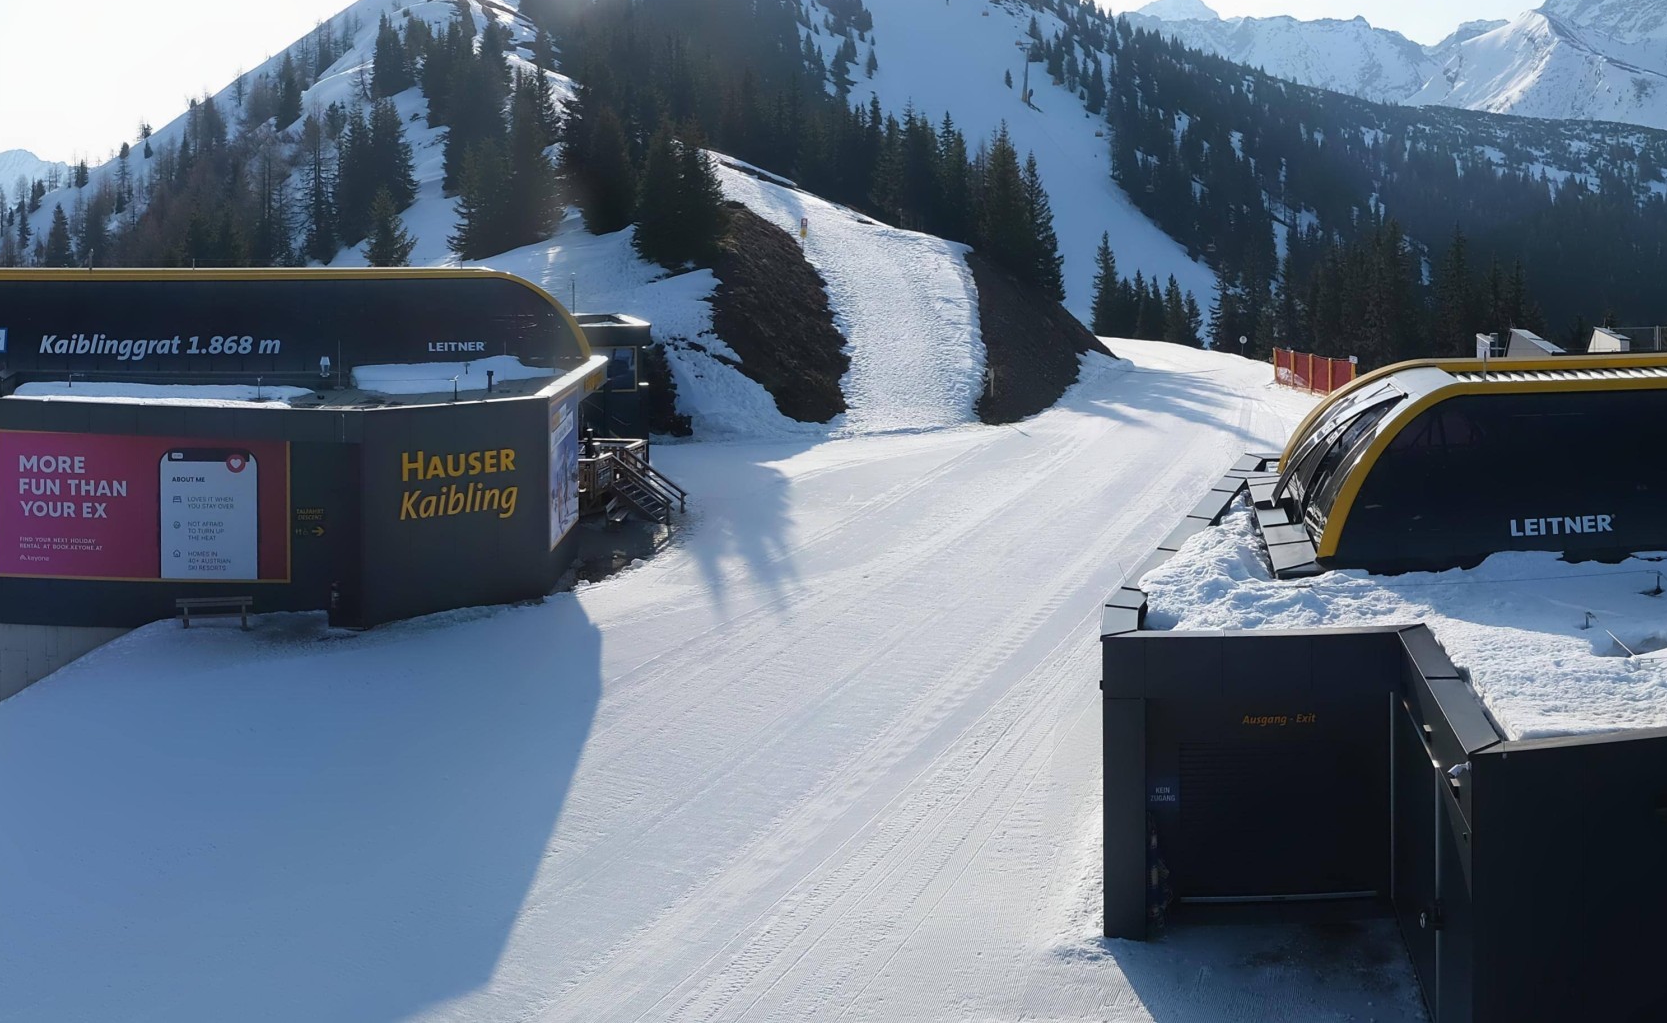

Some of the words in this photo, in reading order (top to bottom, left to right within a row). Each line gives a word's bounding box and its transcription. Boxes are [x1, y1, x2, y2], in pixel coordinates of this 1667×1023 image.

[39, 333, 181, 360] Kaiblinggrat
[186, 335, 253, 354] 1.868
[258, 339, 281, 354] m
[428, 342, 485, 352] LEITNER
[19, 455, 86, 474] MORE
[401, 448, 516, 482] HAUSER
[19, 478, 60, 495] FUN
[67, 479, 127, 497] THAN
[20, 500, 76, 518] YOUR
[82, 502, 107, 518] EX
[400, 482, 518, 520] Kaibling
[1510, 514, 1613, 537] LEITNER
[1242, 714, 1287, 727] Ausgang
[1296, 713, 1317, 723] Exit
[1150, 794, 1176, 802] ZUGANG
[1155, 786, 1170, 794] KEIN
